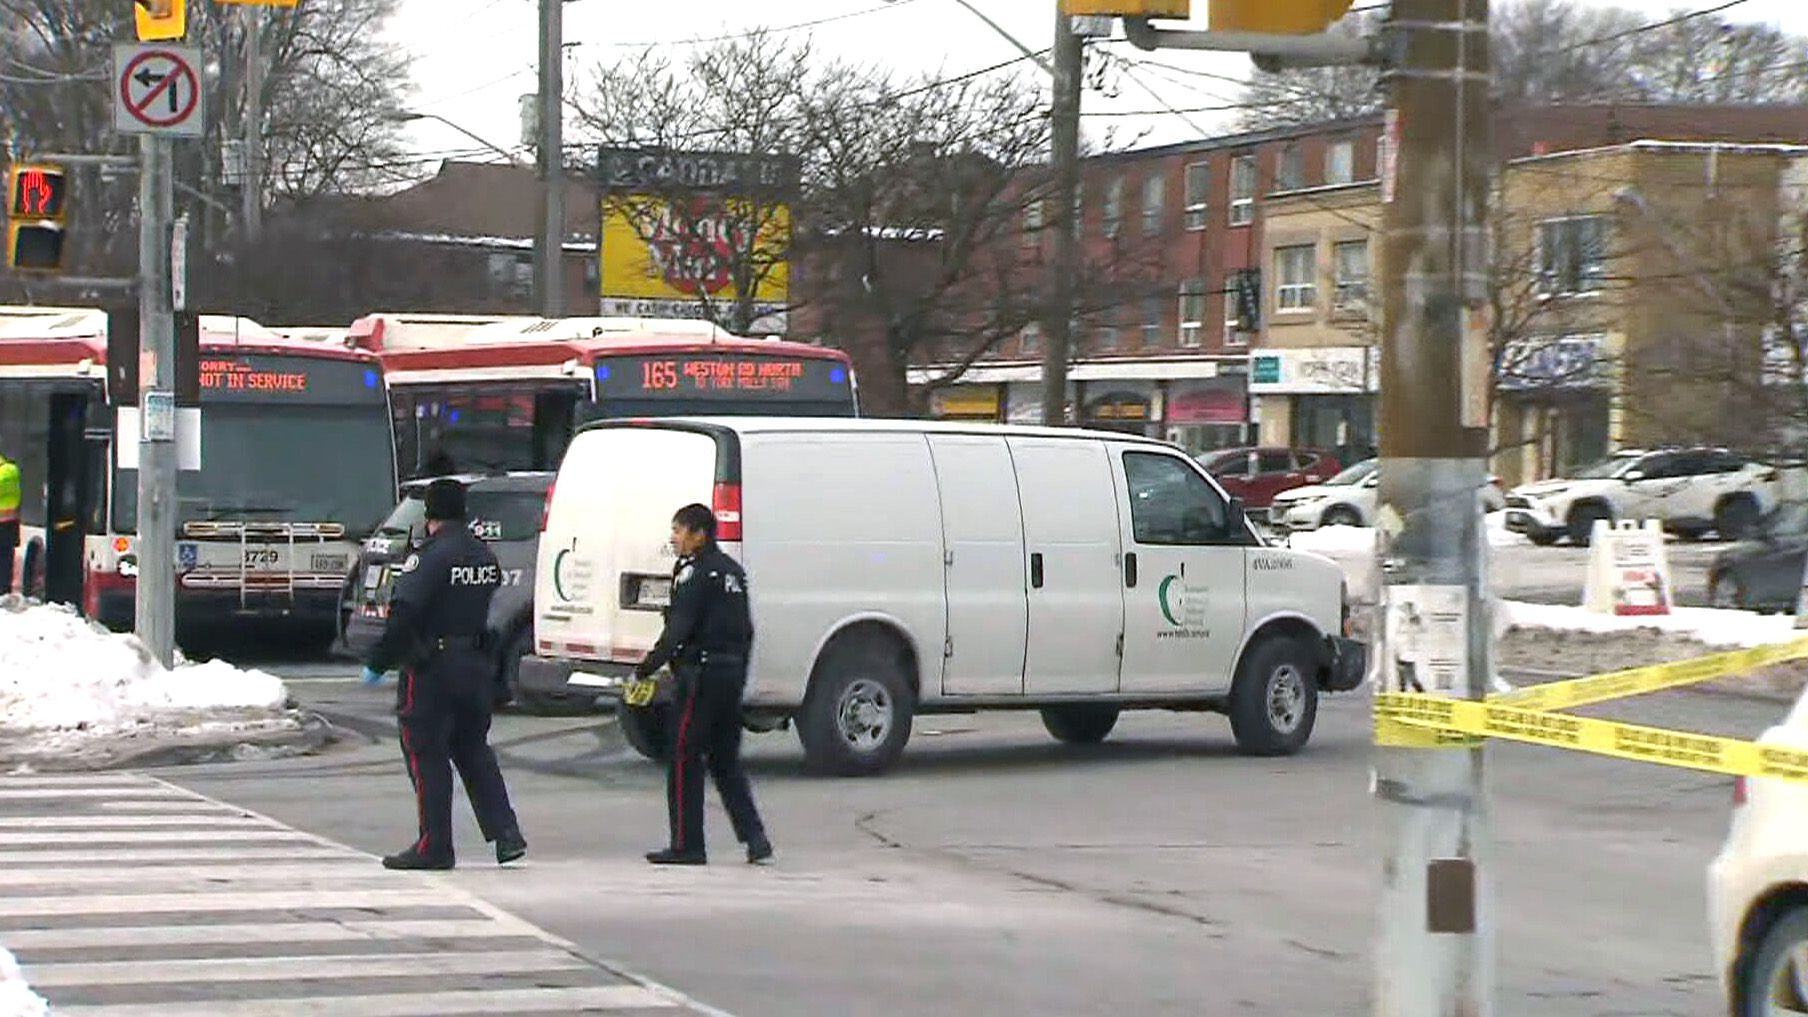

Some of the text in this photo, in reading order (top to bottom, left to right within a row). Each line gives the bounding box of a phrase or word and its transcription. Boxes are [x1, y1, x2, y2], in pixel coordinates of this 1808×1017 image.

[227, 373, 244, 389] IN
[248, 373, 306, 390] SERVICE
[642, 361, 678, 389] 165
[451, 565, 498, 585] POLICE
